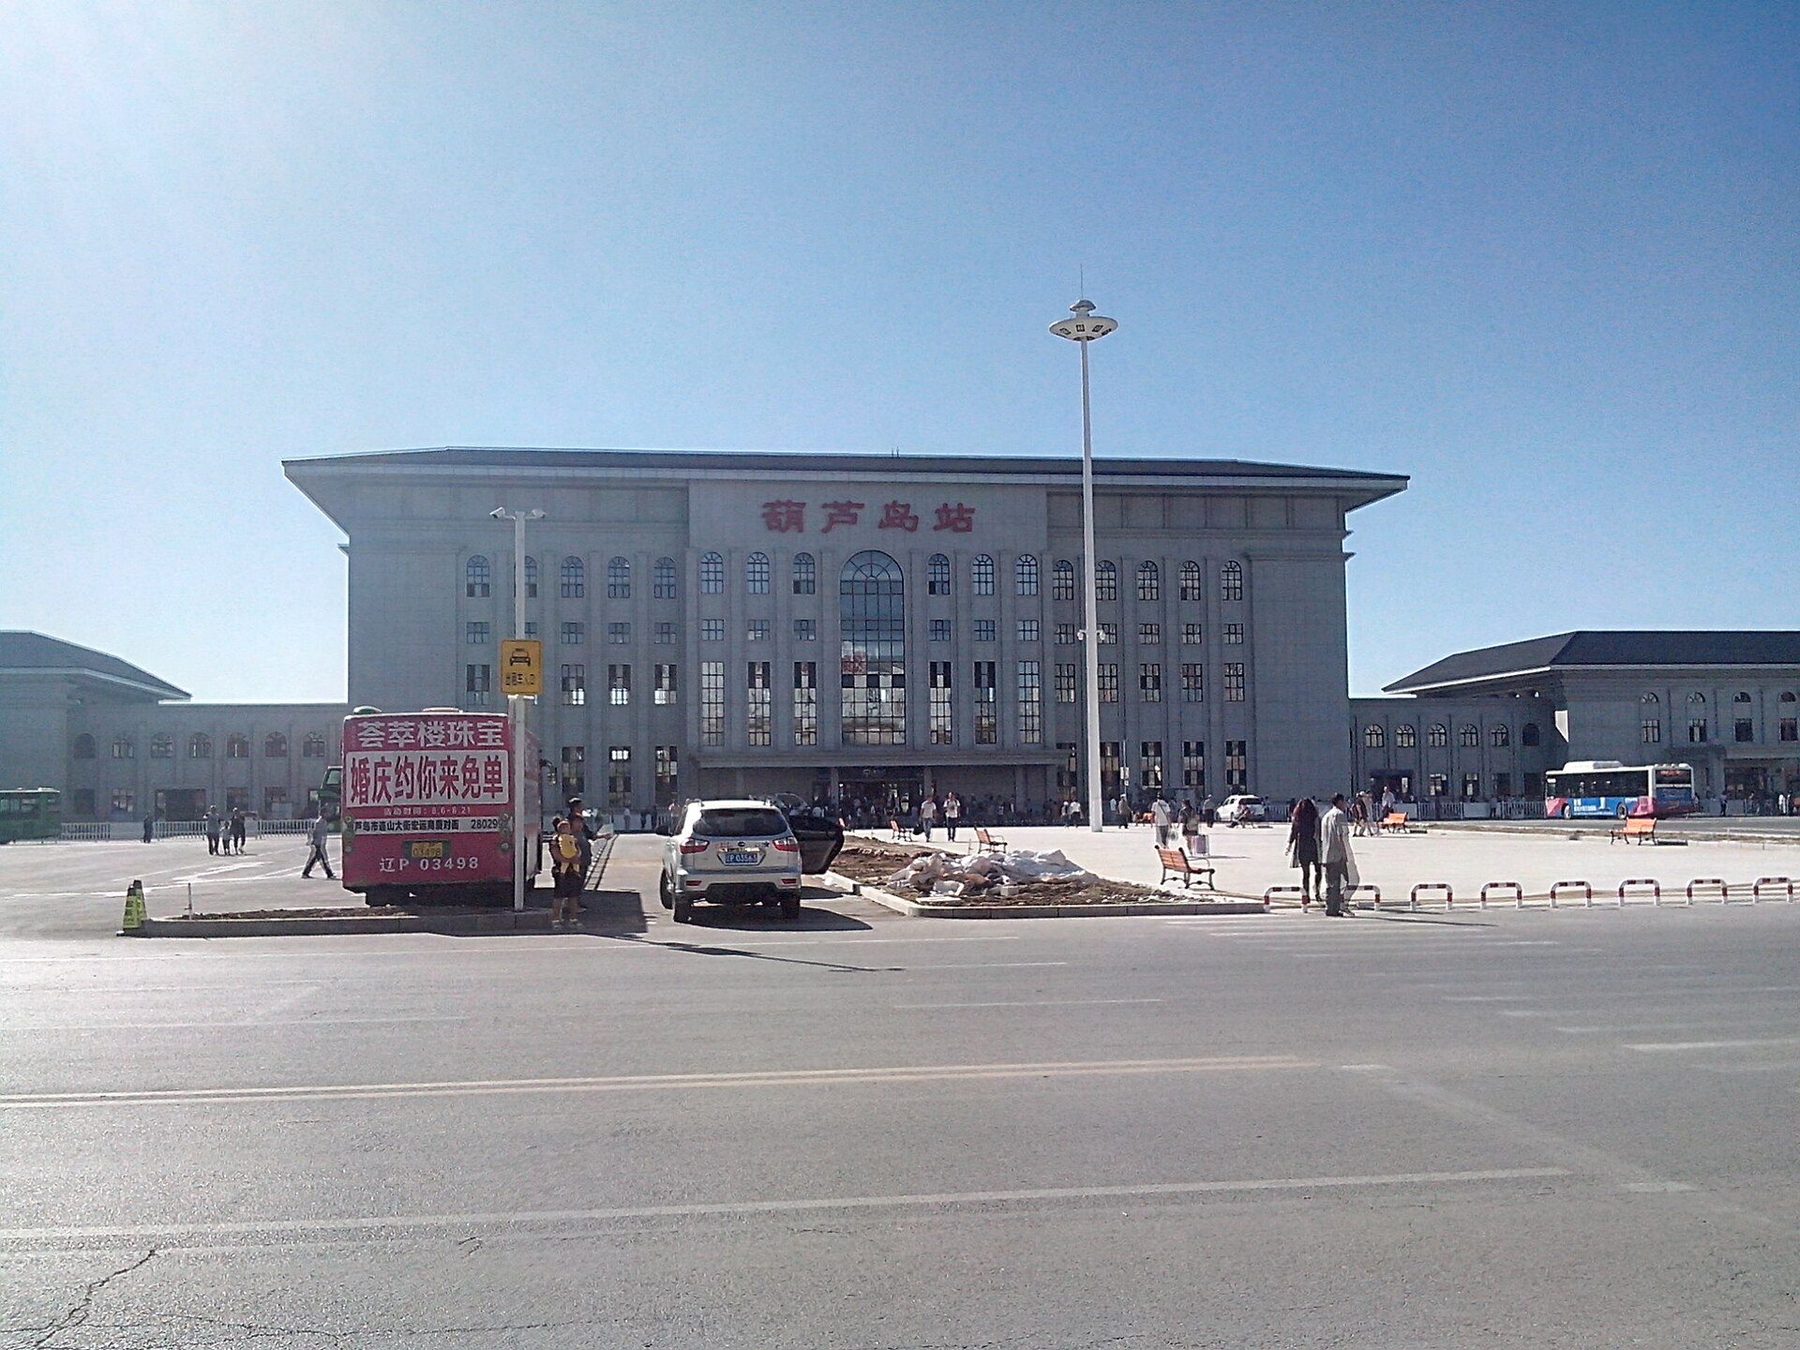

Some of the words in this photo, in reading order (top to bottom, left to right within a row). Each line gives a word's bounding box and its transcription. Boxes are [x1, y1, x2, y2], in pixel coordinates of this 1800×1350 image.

[762, 499, 976, 534] 葫芦岛站
[358, 720, 504, 748] 荟萃楼珠宝
[350, 755, 504, 805] 婚庆约你来免单
[470, 818, 502, 830] 28029
[379, 858, 409, 873] 辽P
[419, 857, 479, 871] 03498
